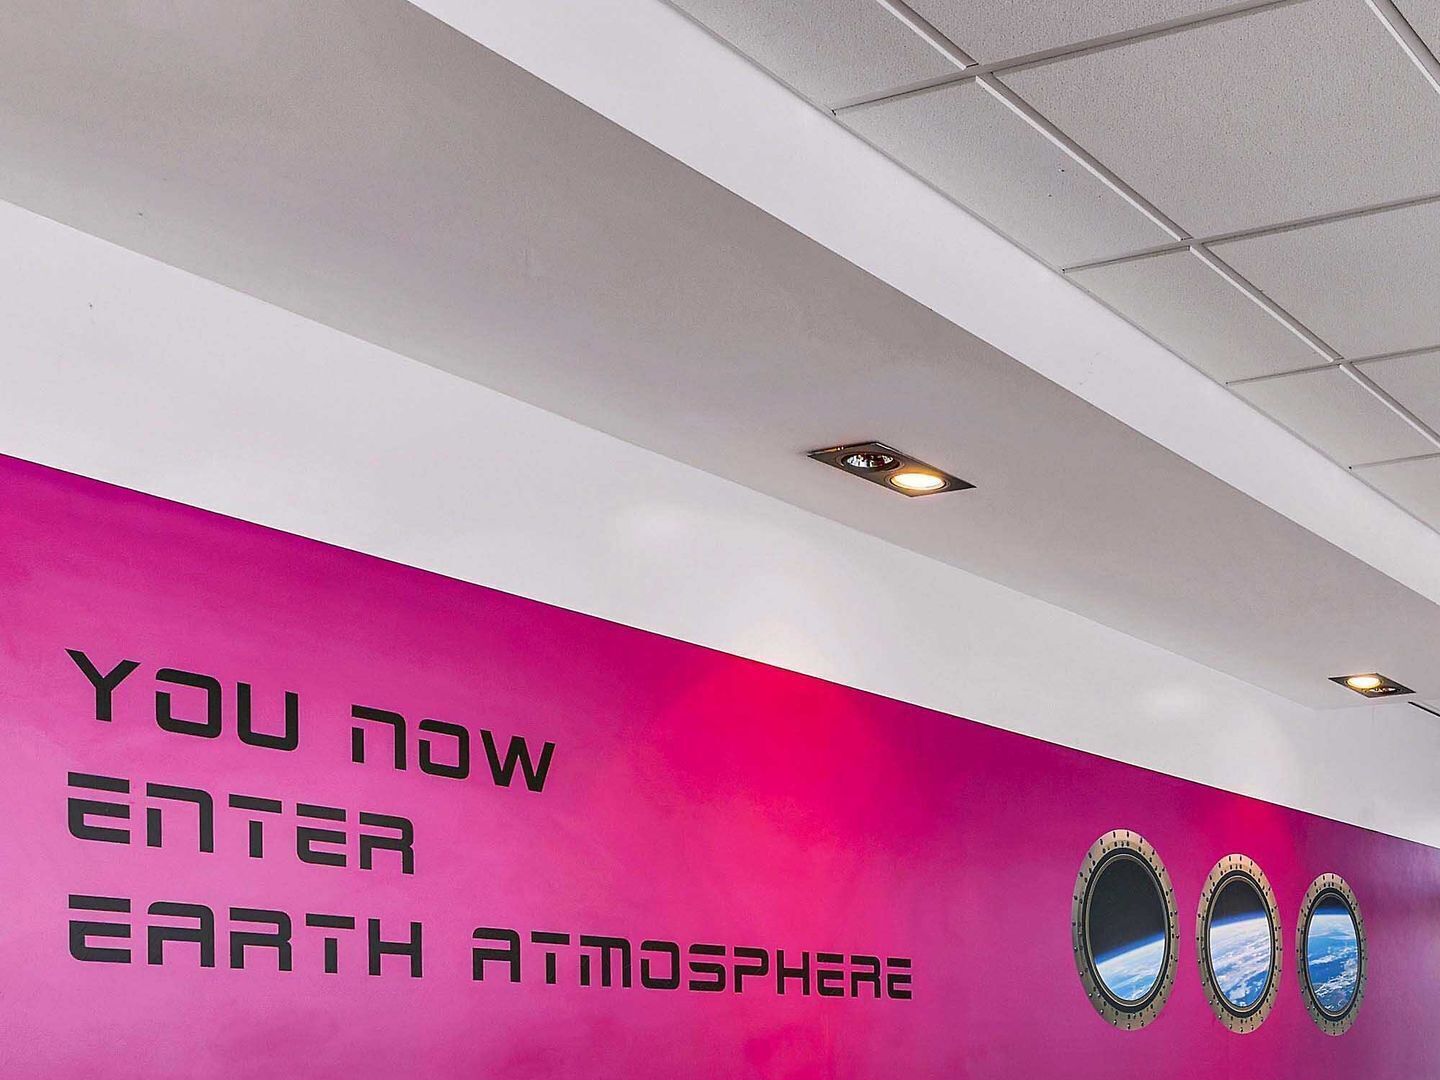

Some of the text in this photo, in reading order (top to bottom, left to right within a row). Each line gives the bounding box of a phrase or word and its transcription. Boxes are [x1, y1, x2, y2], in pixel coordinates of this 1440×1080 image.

[65, 648, 556, 793] YOU NOW
[67, 771, 415, 875] ENTER
[68, 894, 912, 1000] EARTH ATMOSPHERE
